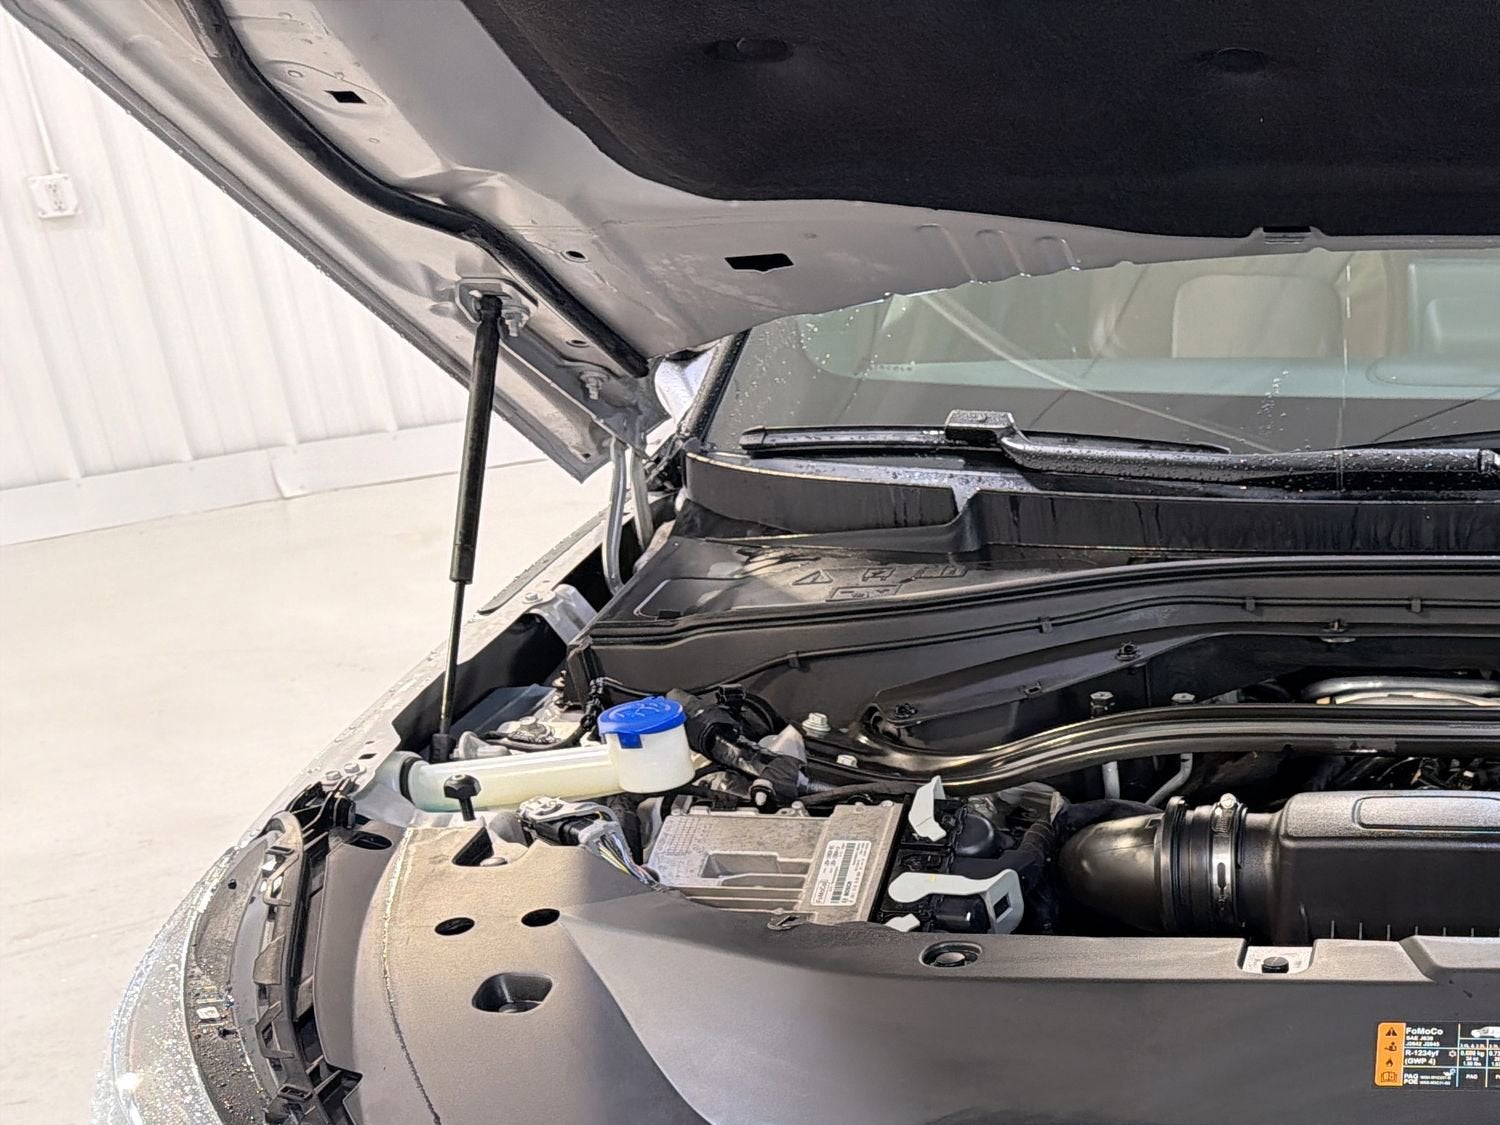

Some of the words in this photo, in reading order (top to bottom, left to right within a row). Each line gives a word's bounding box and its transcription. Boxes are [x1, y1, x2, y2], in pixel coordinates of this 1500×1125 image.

[1406, 1027, 1444, 1035] FoMoCo
[1405, 1050, 1440, 1058] R-1234yf
[1404, 1057, 1427, 1065] (GWP
[1428, 1057, 1437, 1065] 4)
